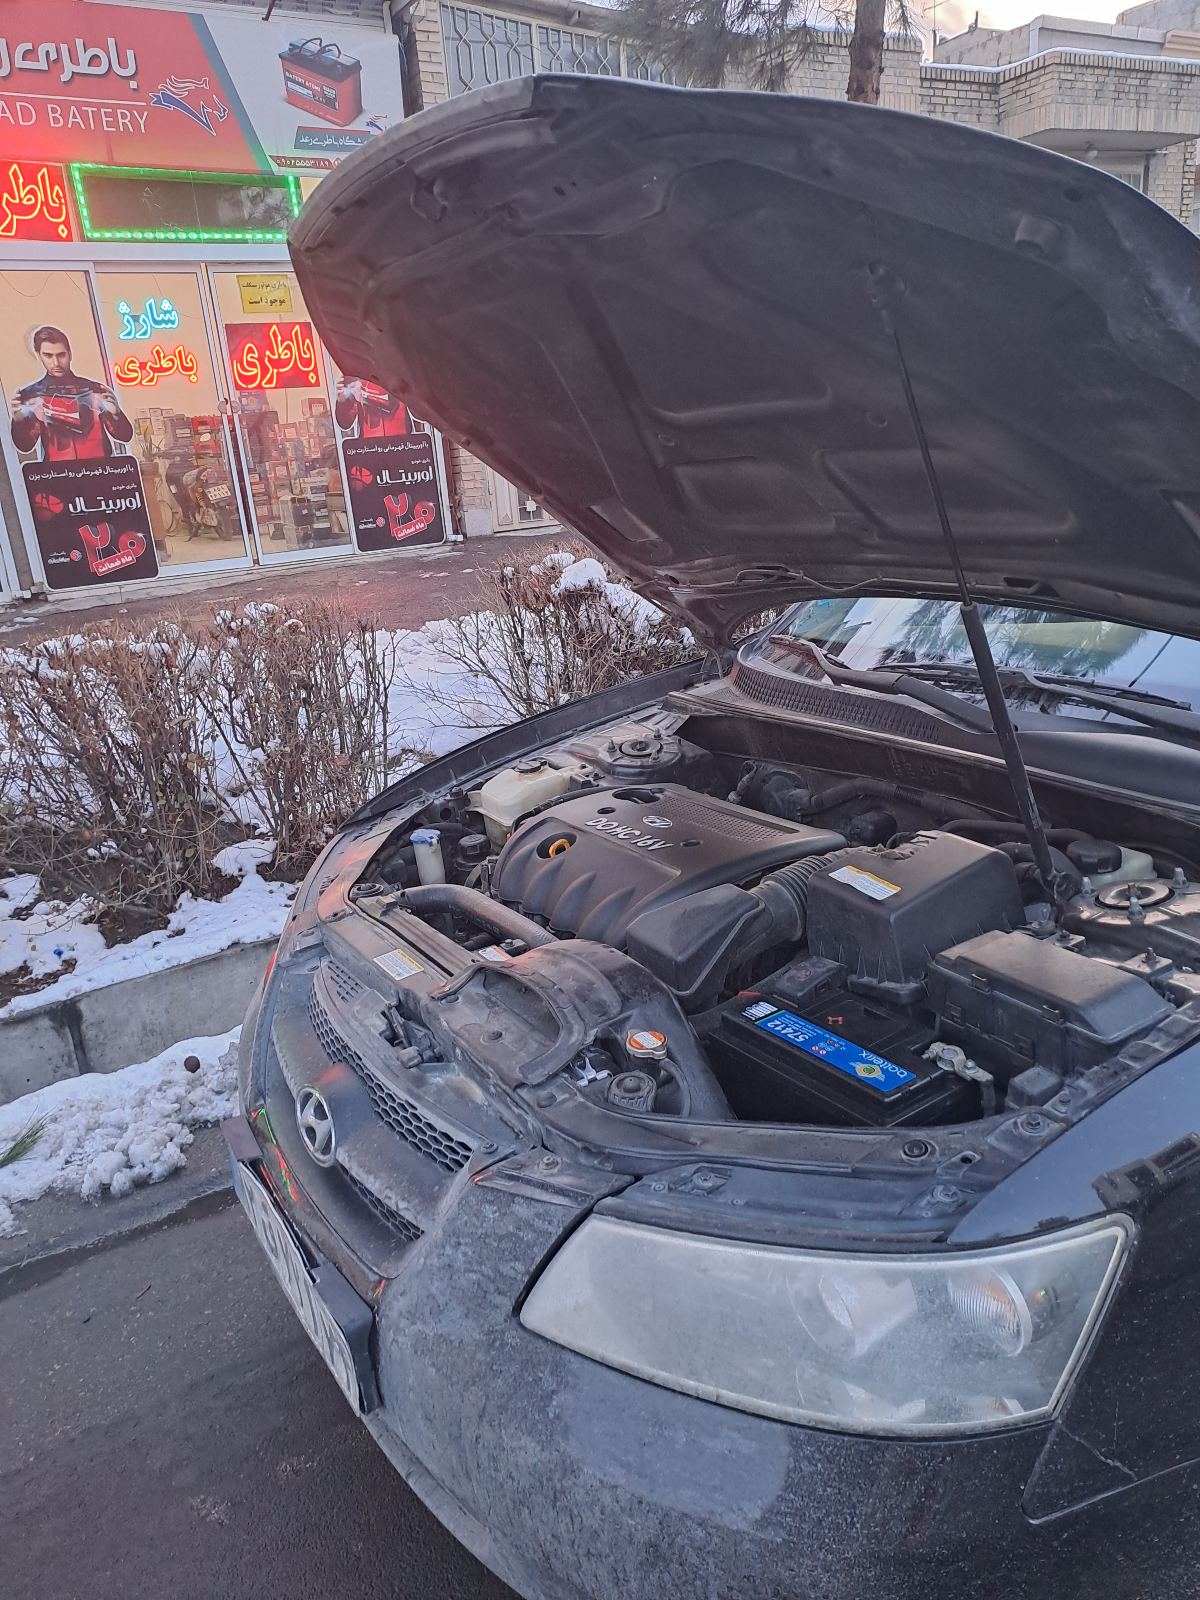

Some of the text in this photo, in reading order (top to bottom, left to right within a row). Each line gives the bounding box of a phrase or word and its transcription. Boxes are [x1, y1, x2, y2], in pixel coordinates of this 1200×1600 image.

[15, 37, 138, 89] باطری
[47, 103, 148, 133] BATERY
[118, 298, 179, 340] شارژ
[114, 345, 198, 386] باطری
[233, 324, 317, 389] باطری
[376, 465, 434, 485] اوربیتال
[68, 492, 141, 514] اوربیتال
[584, 817, 675, 851] DOHC 16V
[767, 1019, 809, 1042] 57412
